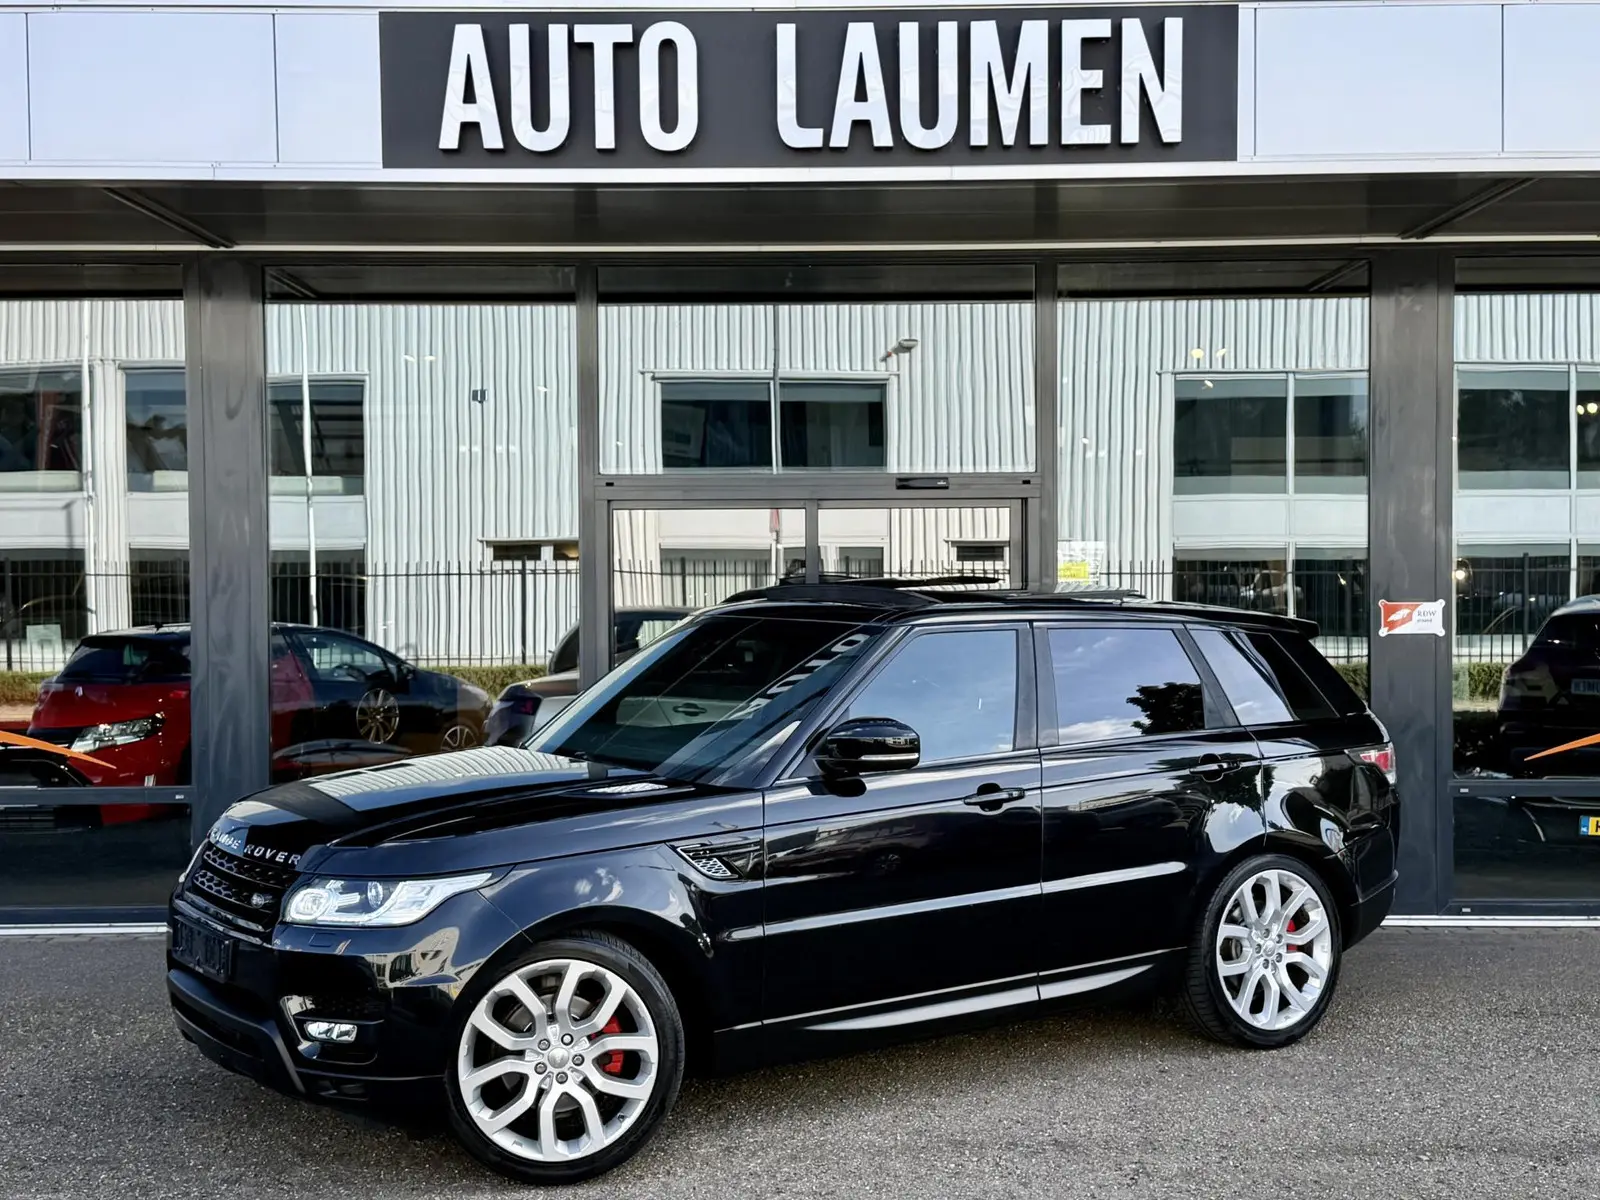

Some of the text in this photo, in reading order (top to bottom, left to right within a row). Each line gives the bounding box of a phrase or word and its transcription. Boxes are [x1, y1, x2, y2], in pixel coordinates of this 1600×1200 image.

[438, 17, 1184, 152] AUTO LAUMEN
[243, 844, 301, 865] ROVER
